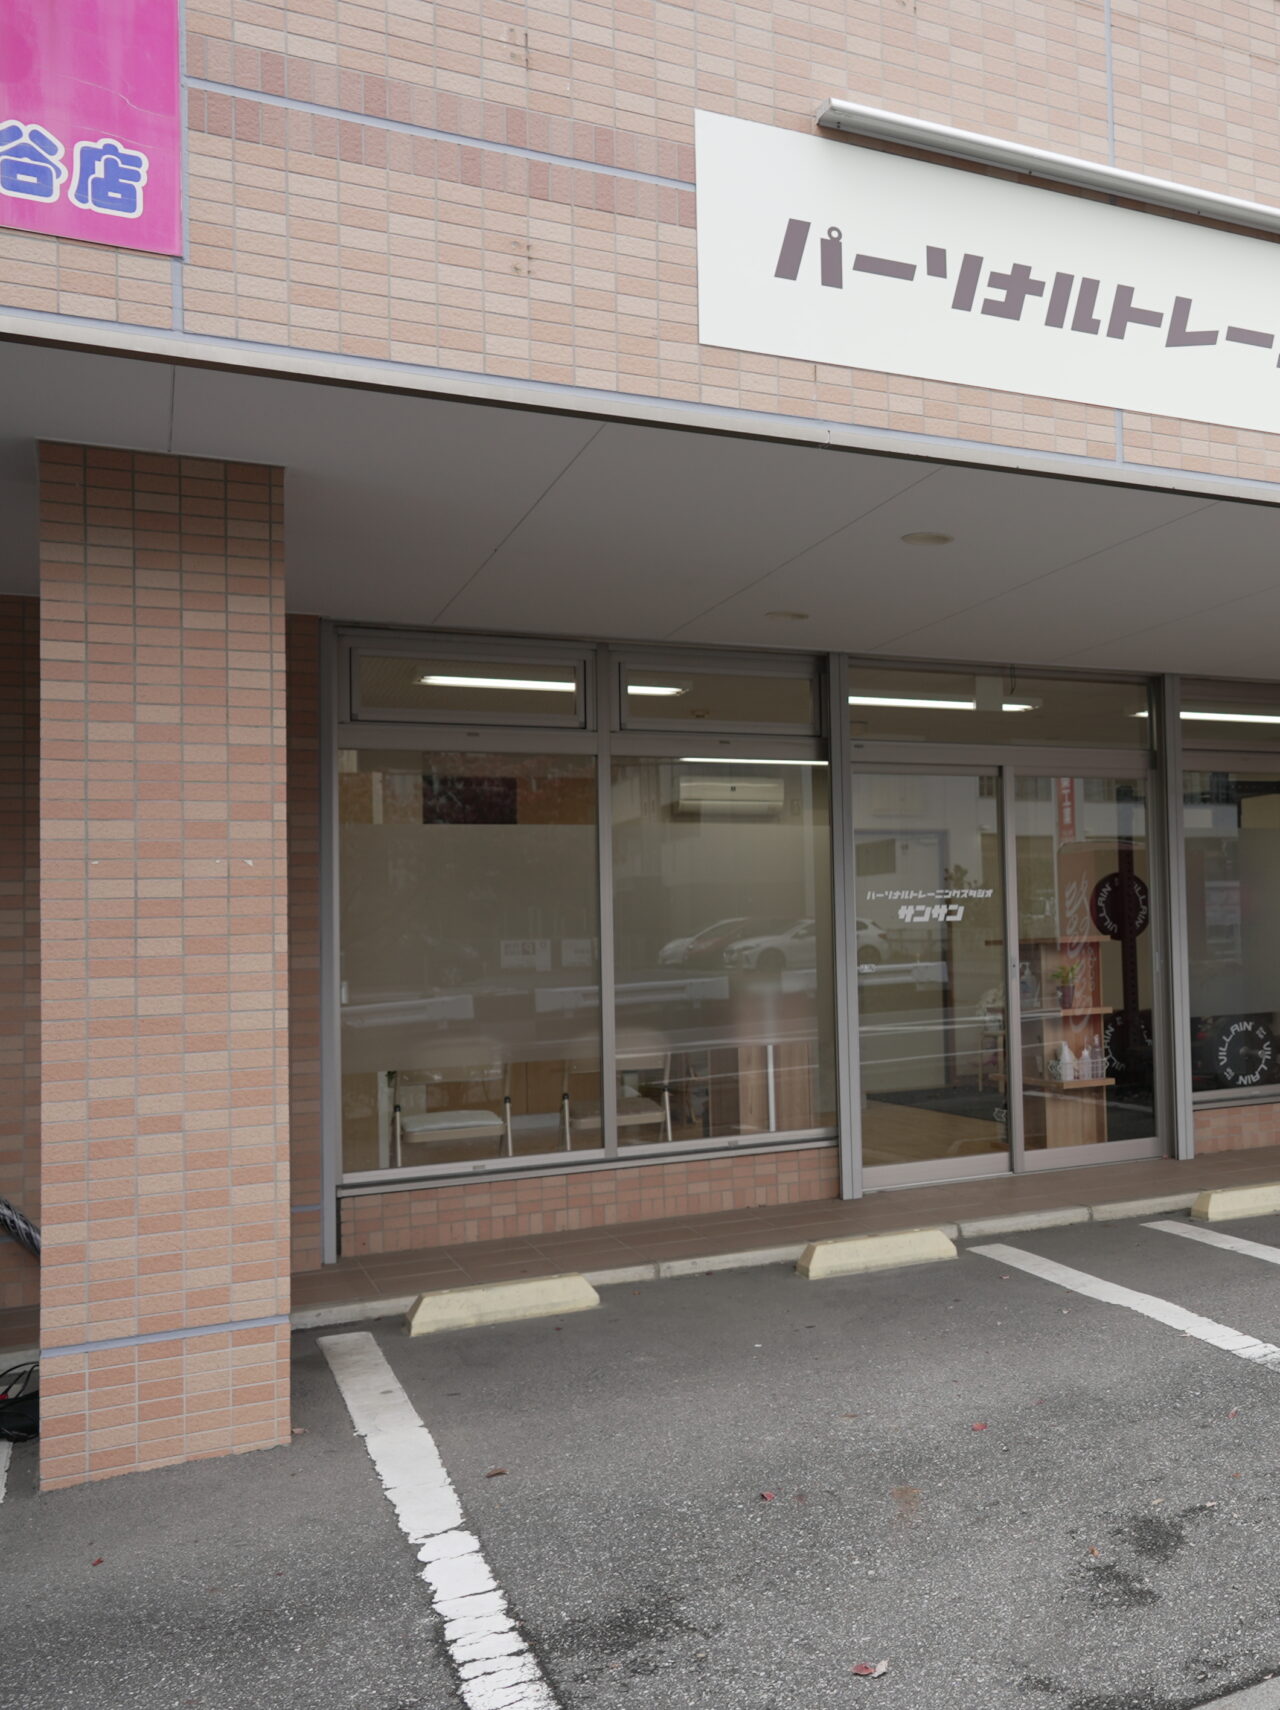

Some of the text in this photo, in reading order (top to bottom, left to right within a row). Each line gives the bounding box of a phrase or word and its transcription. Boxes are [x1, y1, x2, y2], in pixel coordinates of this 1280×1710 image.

[0, 121, 147, 217] 谷店
[898, 904, 965, 923] サンサン
[1218, 1021, 1255, 1066] VILLAIN
